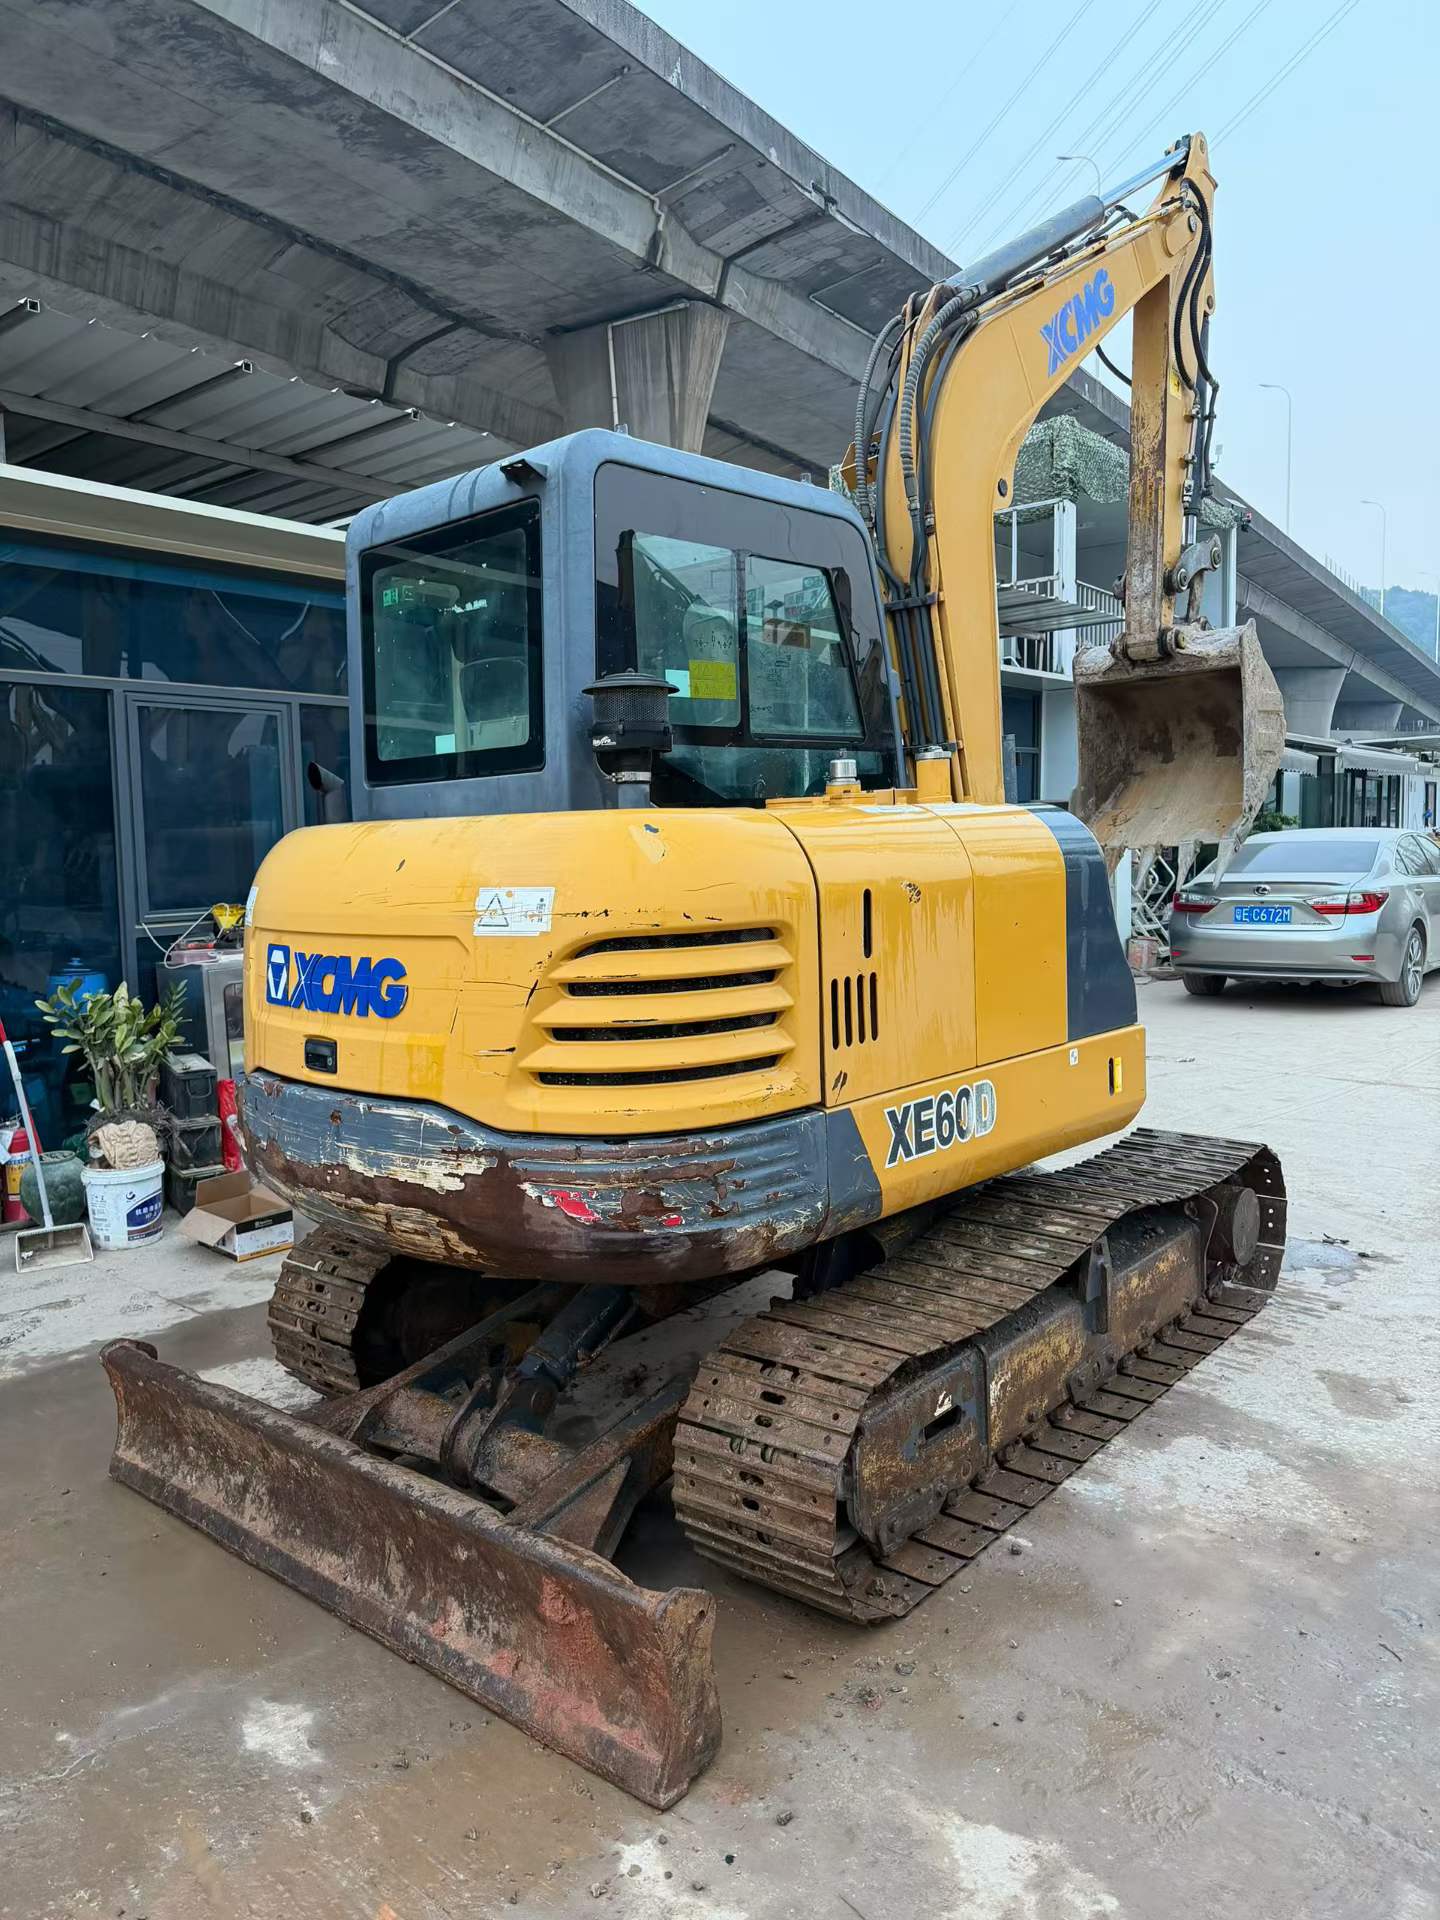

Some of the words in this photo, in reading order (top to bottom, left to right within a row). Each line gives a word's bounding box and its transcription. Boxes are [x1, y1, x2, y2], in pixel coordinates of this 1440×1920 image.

[1040, 268, 1115, 378] XCMG
[290, 951, 409, 1019] XCMG
[884, 1079, 997, 1169] XE60D
